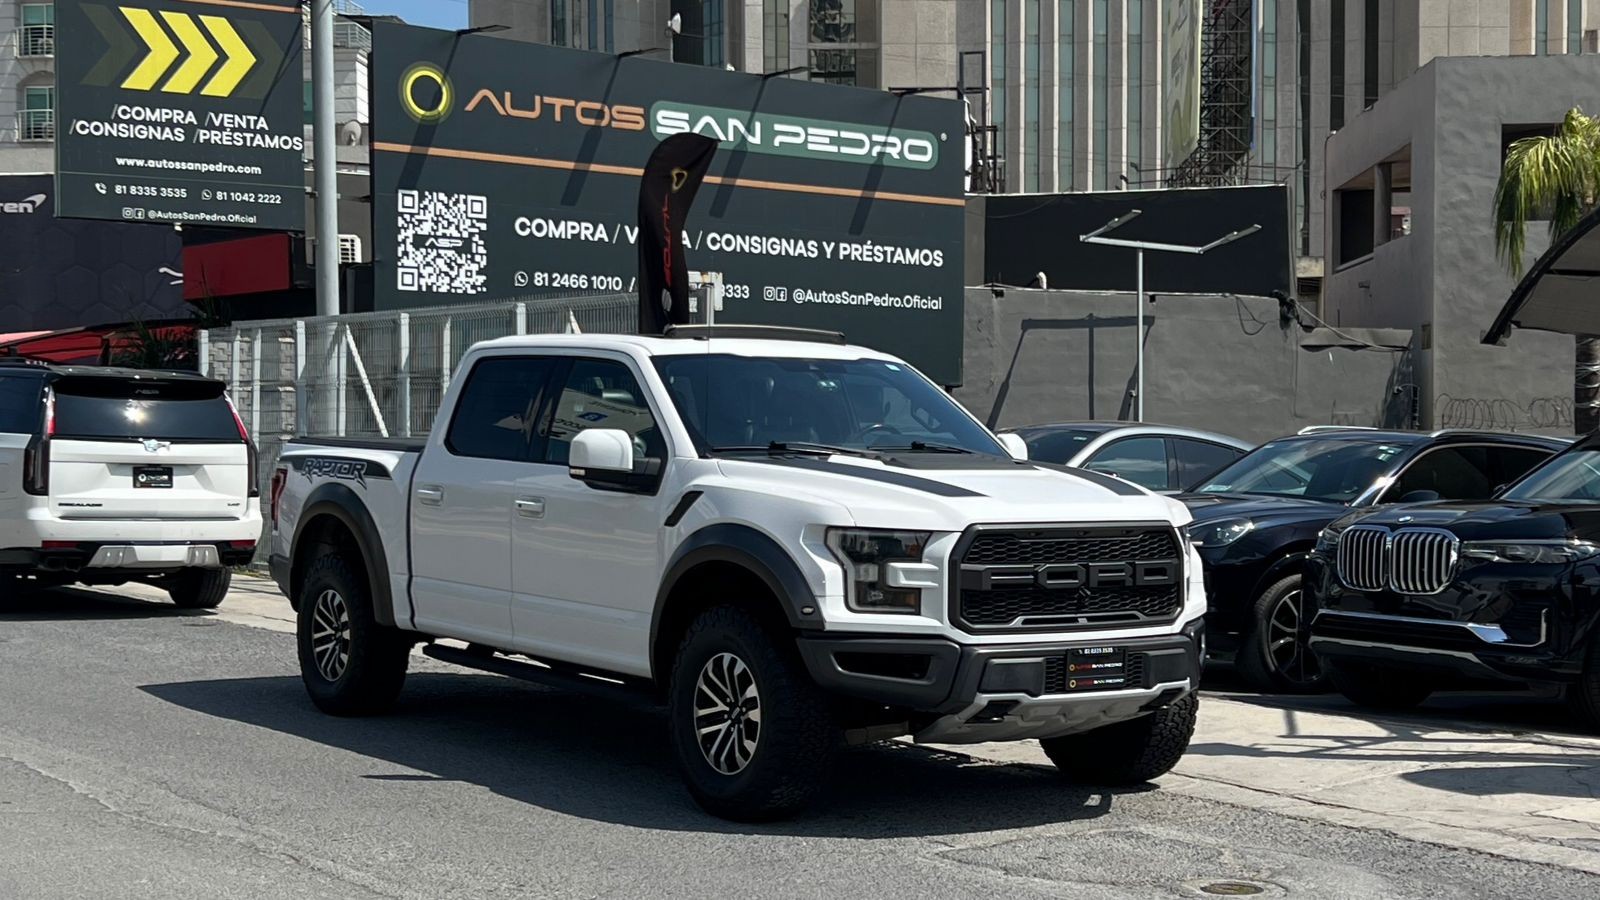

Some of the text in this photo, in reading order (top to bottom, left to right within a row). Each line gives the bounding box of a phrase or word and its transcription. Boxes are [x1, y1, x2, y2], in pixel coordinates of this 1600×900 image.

[464, 88, 933, 162] AUTOS SAN PEDRO
[116, 157, 262, 175] www.autossanpedro.com
[114, 185, 188, 198] 81 8335 3535
[216, 190, 282, 204] 81 1042 2222
[148, 209, 257, 224] @AutosSanPedro.Oficial
[514, 216, 610, 243] COMPRA
[706, 231, 819, 259] CONSIGNAS
[821, 241, 836, 259] Y
[838, 238, 944, 268] PRÉSTAMOS
[533, 271, 549, 287] 81
[551, 272, 589, 289] 2466
[591, 275, 623, 290] 1010
[792, 288, 942, 310] @AutosSanPedro.Oficial
[301, 458, 368, 490] RAPTOR
[979, 561, 1178, 590] FORD
